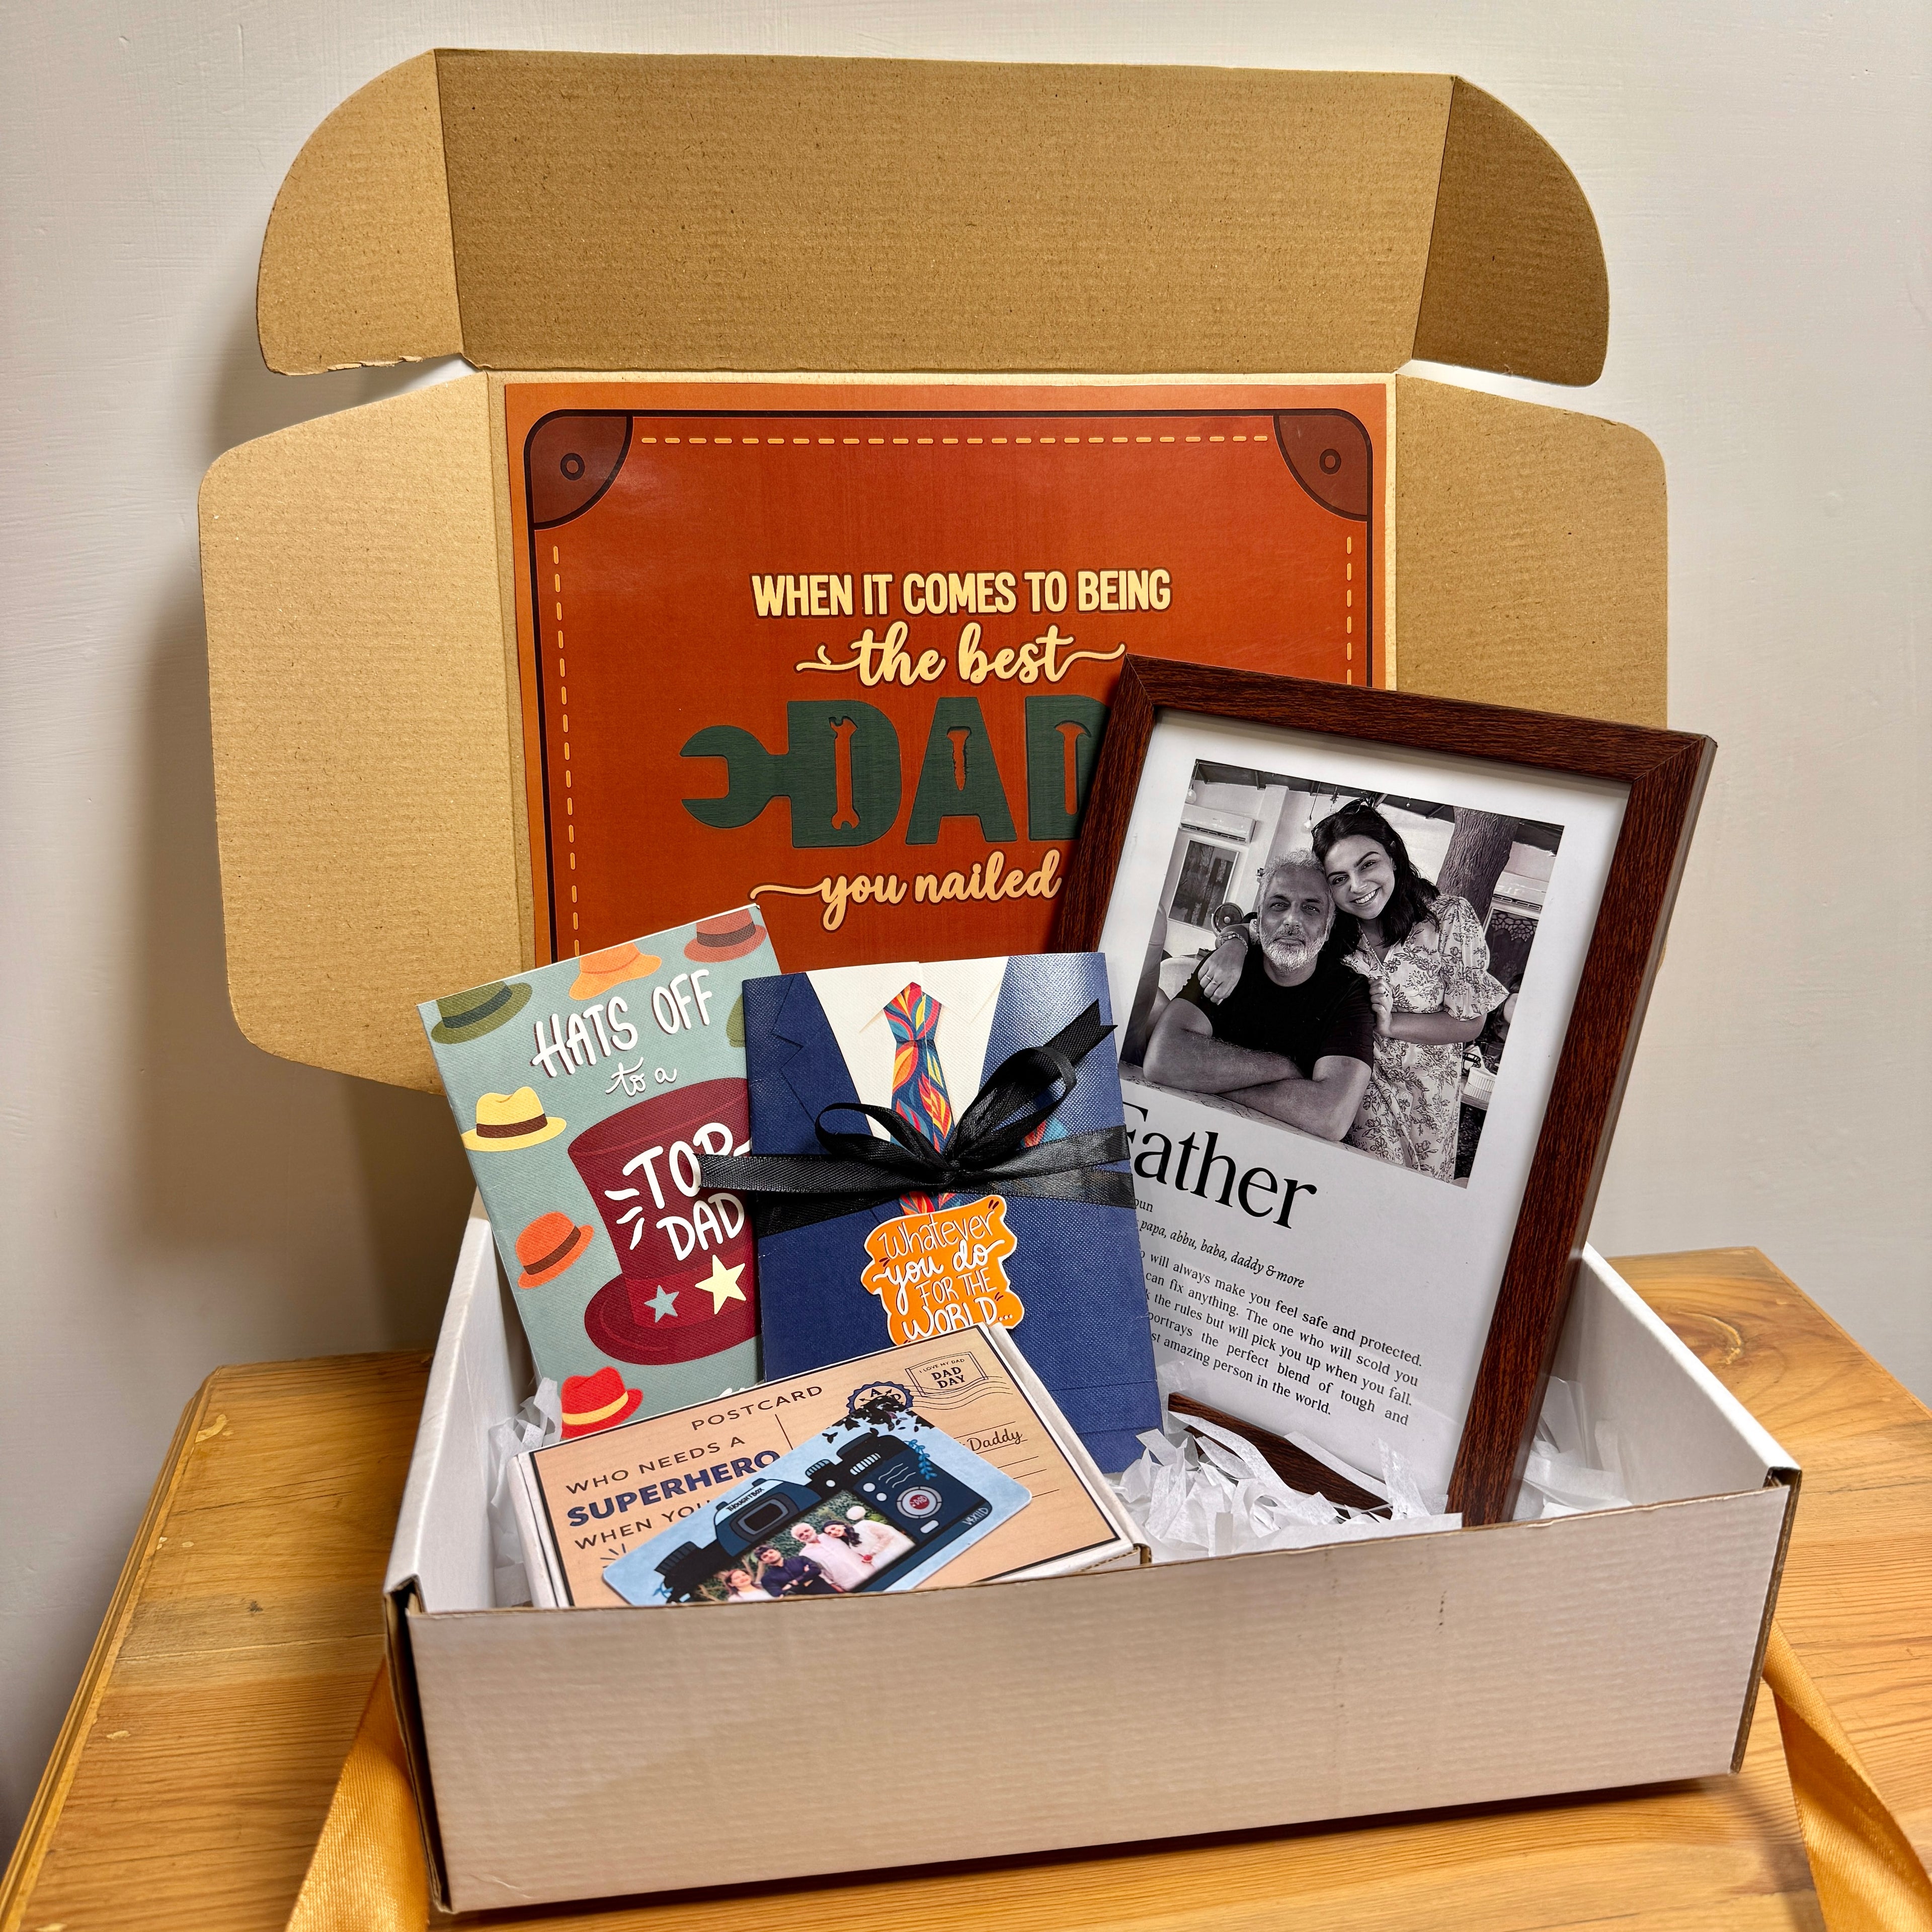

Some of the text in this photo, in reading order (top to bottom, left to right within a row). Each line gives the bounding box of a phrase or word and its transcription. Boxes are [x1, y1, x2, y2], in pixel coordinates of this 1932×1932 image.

[752, 569, 1171, 616] WHEN IT COMES TO BEING
[796, 621, 1125, 685] the best
[788, 696, 1111, 848] DAD
[750, 849, 1062, 931] you nailed
[531, 969, 713, 1078] HATS OFF
[605, 1057, 677, 1096] to a
[656, 1192, 745, 1260] DAD
[877, 1210, 995, 1259] Whatever
[1135, 1199, 1153, 1213] oun
[1139, 1220, 1167, 1238] papa,
[1170, 1230, 1197, 1250] abbu,
[1200, 1239, 1228, 1261] baba,
[1231, 1252, 1264, 1274] daddy
[872, 1239, 1005, 1315] you do
[915, 1266, 997, 1306] FOR THE
[1146, 1272, 1418, 1387] can fix anything. The one who will scold you
[1151, 1254, 1170, 1268] will
[1173, 1263, 1210, 1284] always
[1215, 1279, 1245, 1297] make
[1249, 1292, 1270, 1308] you
[1275, 1300, 1298, 1318] feel
[1302, 1313, 1328, 1329] safe
[1332, 1325, 1356, 1340] and
[1359, 1335, 1422, 1366] protected.
[931, 1367, 961, 1380] DAD
[1151, 1333, 1331, 1415] st amazing person in the world.
[1155, 1294, 1171, 1308] the
[1174, 1303, 1202, 1320] rules
[1206, 1313, 1225, 1329] but
[1229, 1324, 1249, 1339] will
[1251, 1334, 1276, 1351] pick
[1279, 1345, 1302, 1361] you
[1306, 1355, 1321, 1371] up
[1325, 1362, 1357, 1384] when
[1361, 1378, 1385, 1395] you
[1389, 1387, 1412, 1406] fall.
[1201, 1332, 1219, 1347] the
[1227, 1344, 1269, 1368] perfect
[1277, 1362, 1310, 1385] blend
[1319, 1382, 1334, 1394] of
[1340, 1389, 1375, 1412] tough
[1385, 1410, 1408, 1426] and
[691, 1386, 823, 1430] POSTCARD
[937, 1375, 965, 1389] DAY
[566, 1436, 746, 1494] WHO NEEDS A
[967, 1428, 1022, 1452] Daddy
[567, 1450, 780, 1527] SUPERHERO
[726, 1487, 765, 1512] THOUGHTBOX
[575, 1518, 653, 1550] WHEN
